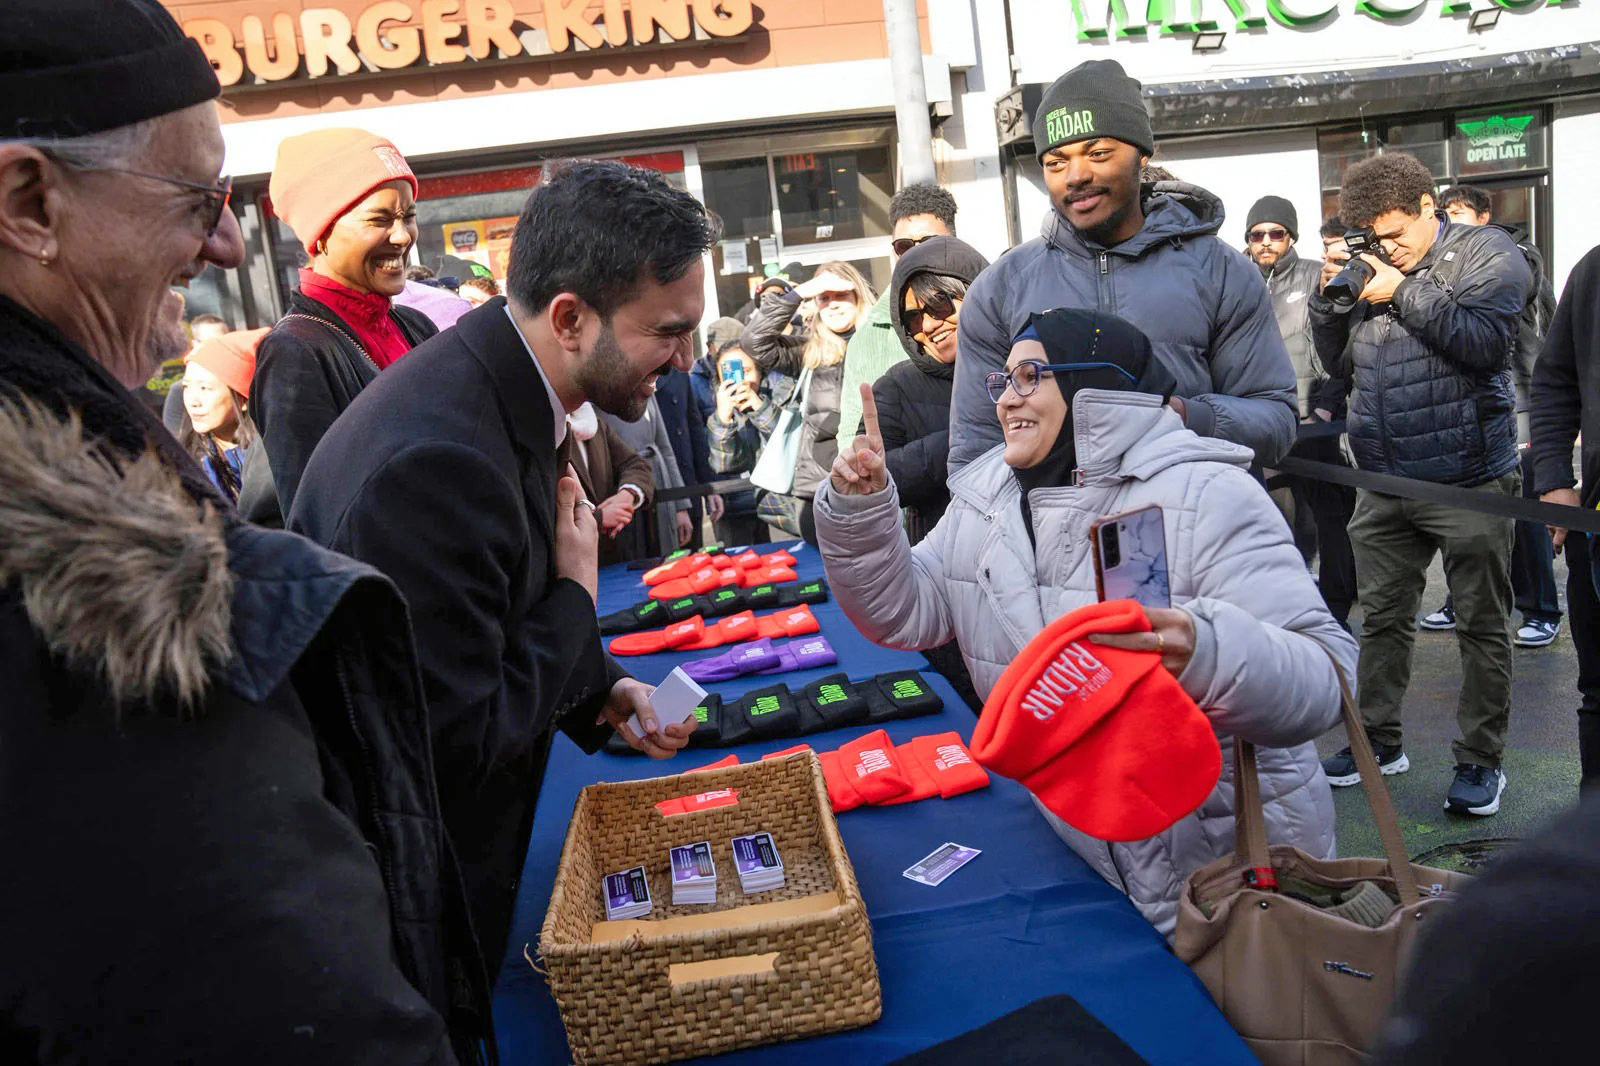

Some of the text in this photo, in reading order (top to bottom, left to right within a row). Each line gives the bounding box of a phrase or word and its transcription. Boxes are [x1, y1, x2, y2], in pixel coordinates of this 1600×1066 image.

[183, 0, 753, 87] BURGER KING
[1046, 110, 1095, 145] RADAR
[1467, 143, 1527, 163] OPEN LATE
[1020, 641, 1103, 721] RADAR
